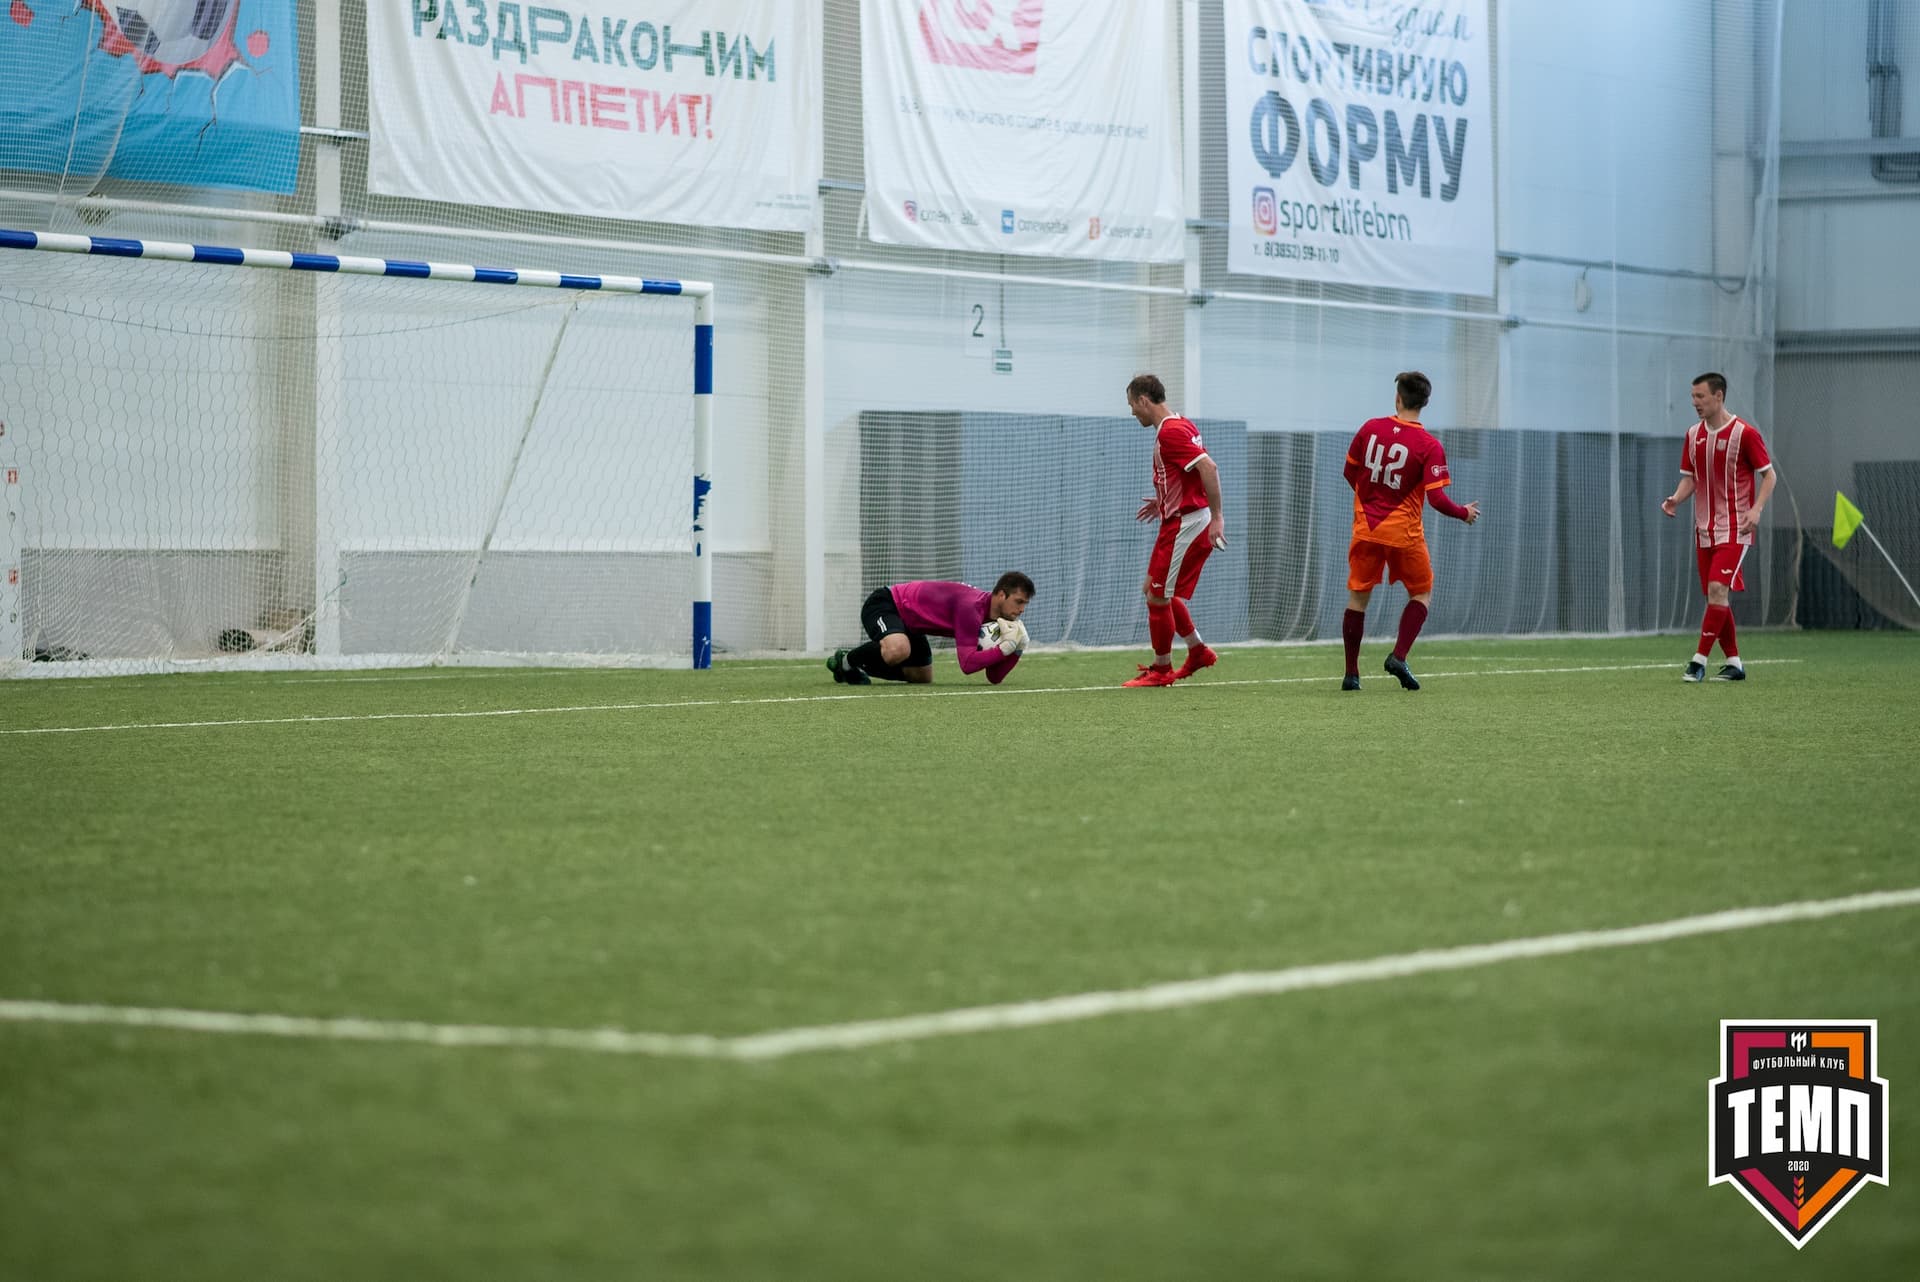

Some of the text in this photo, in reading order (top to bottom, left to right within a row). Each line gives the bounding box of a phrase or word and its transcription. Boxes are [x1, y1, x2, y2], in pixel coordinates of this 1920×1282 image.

[411, 0, 776, 82] РАЗДРАКОНИМ
[1249, 26, 1468, 107] СПОРТИВНУЮ
[489, 71, 713, 140] АППЕТИТ!
[1250, 90, 1468, 203] ФОРМУ
[1280, 198, 1412, 241] sportlifebrn
[972, 304, 984, 337] 2
[1364, 434, 1408, 490] 42
